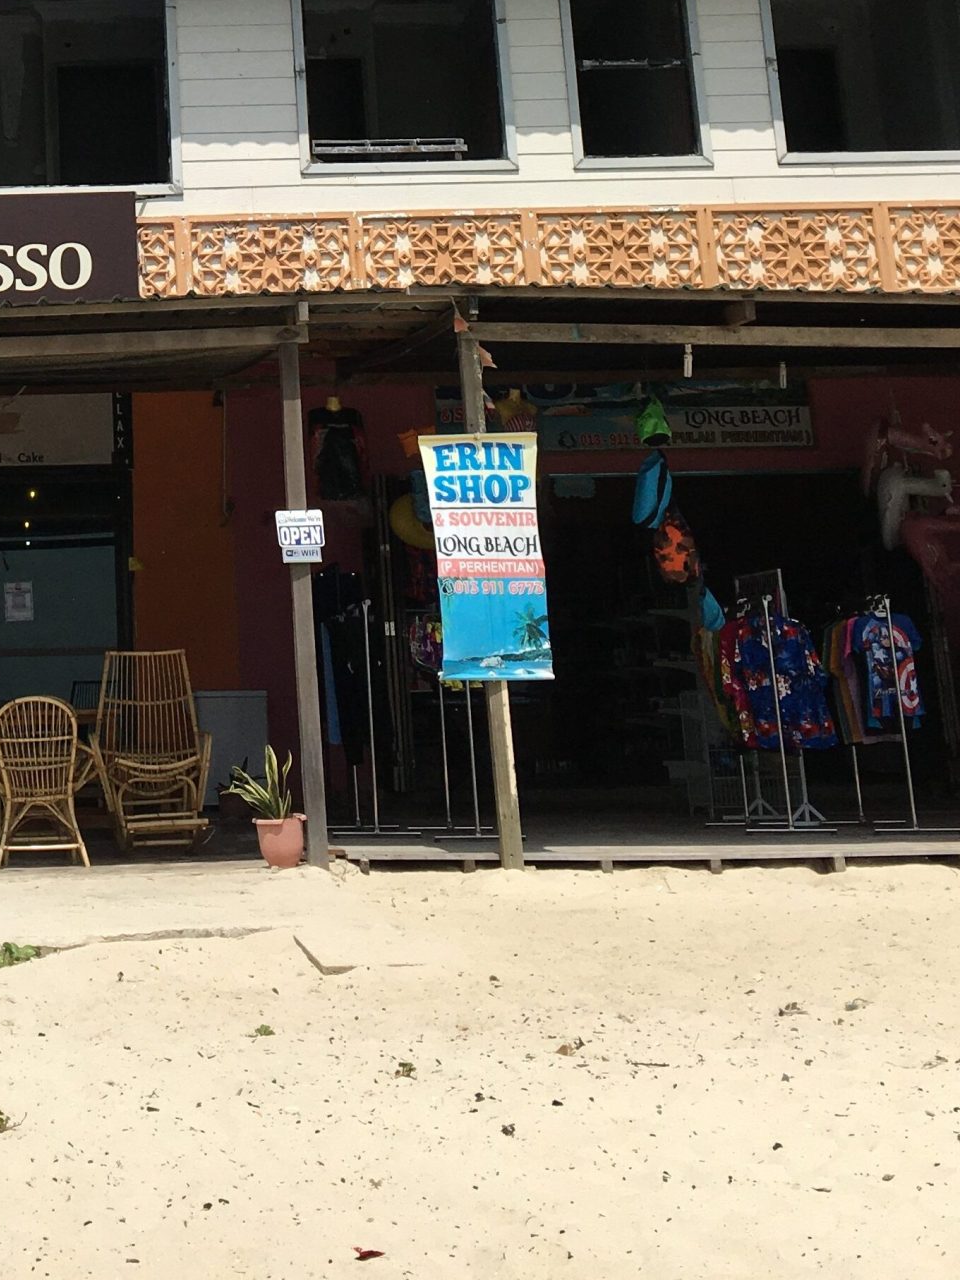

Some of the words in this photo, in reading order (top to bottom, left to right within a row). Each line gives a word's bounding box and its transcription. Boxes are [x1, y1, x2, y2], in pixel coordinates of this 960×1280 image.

[685, 408, 739, 428] LONG
[740, 408, 800, 427] BEACH
[17, 453, 44, 463] Cake
[432, 442, 525, 471] ERIN
[433, 474, 531, 504] SHOP
[435, 513, 444, 527] &
[448, 512, 536, 527] SOUVENIR
[280, 526, 322, 545] OPEN
[301, 549, 319, 557] WIFI
[436, 534, 485, 557] LONG
[484, 534, 538, 557] BEACH
[459, 561, 539, 575] PERHENTIAN)
[454, 580, 479, 595] 013
[482, 580, 504, 595] 911
